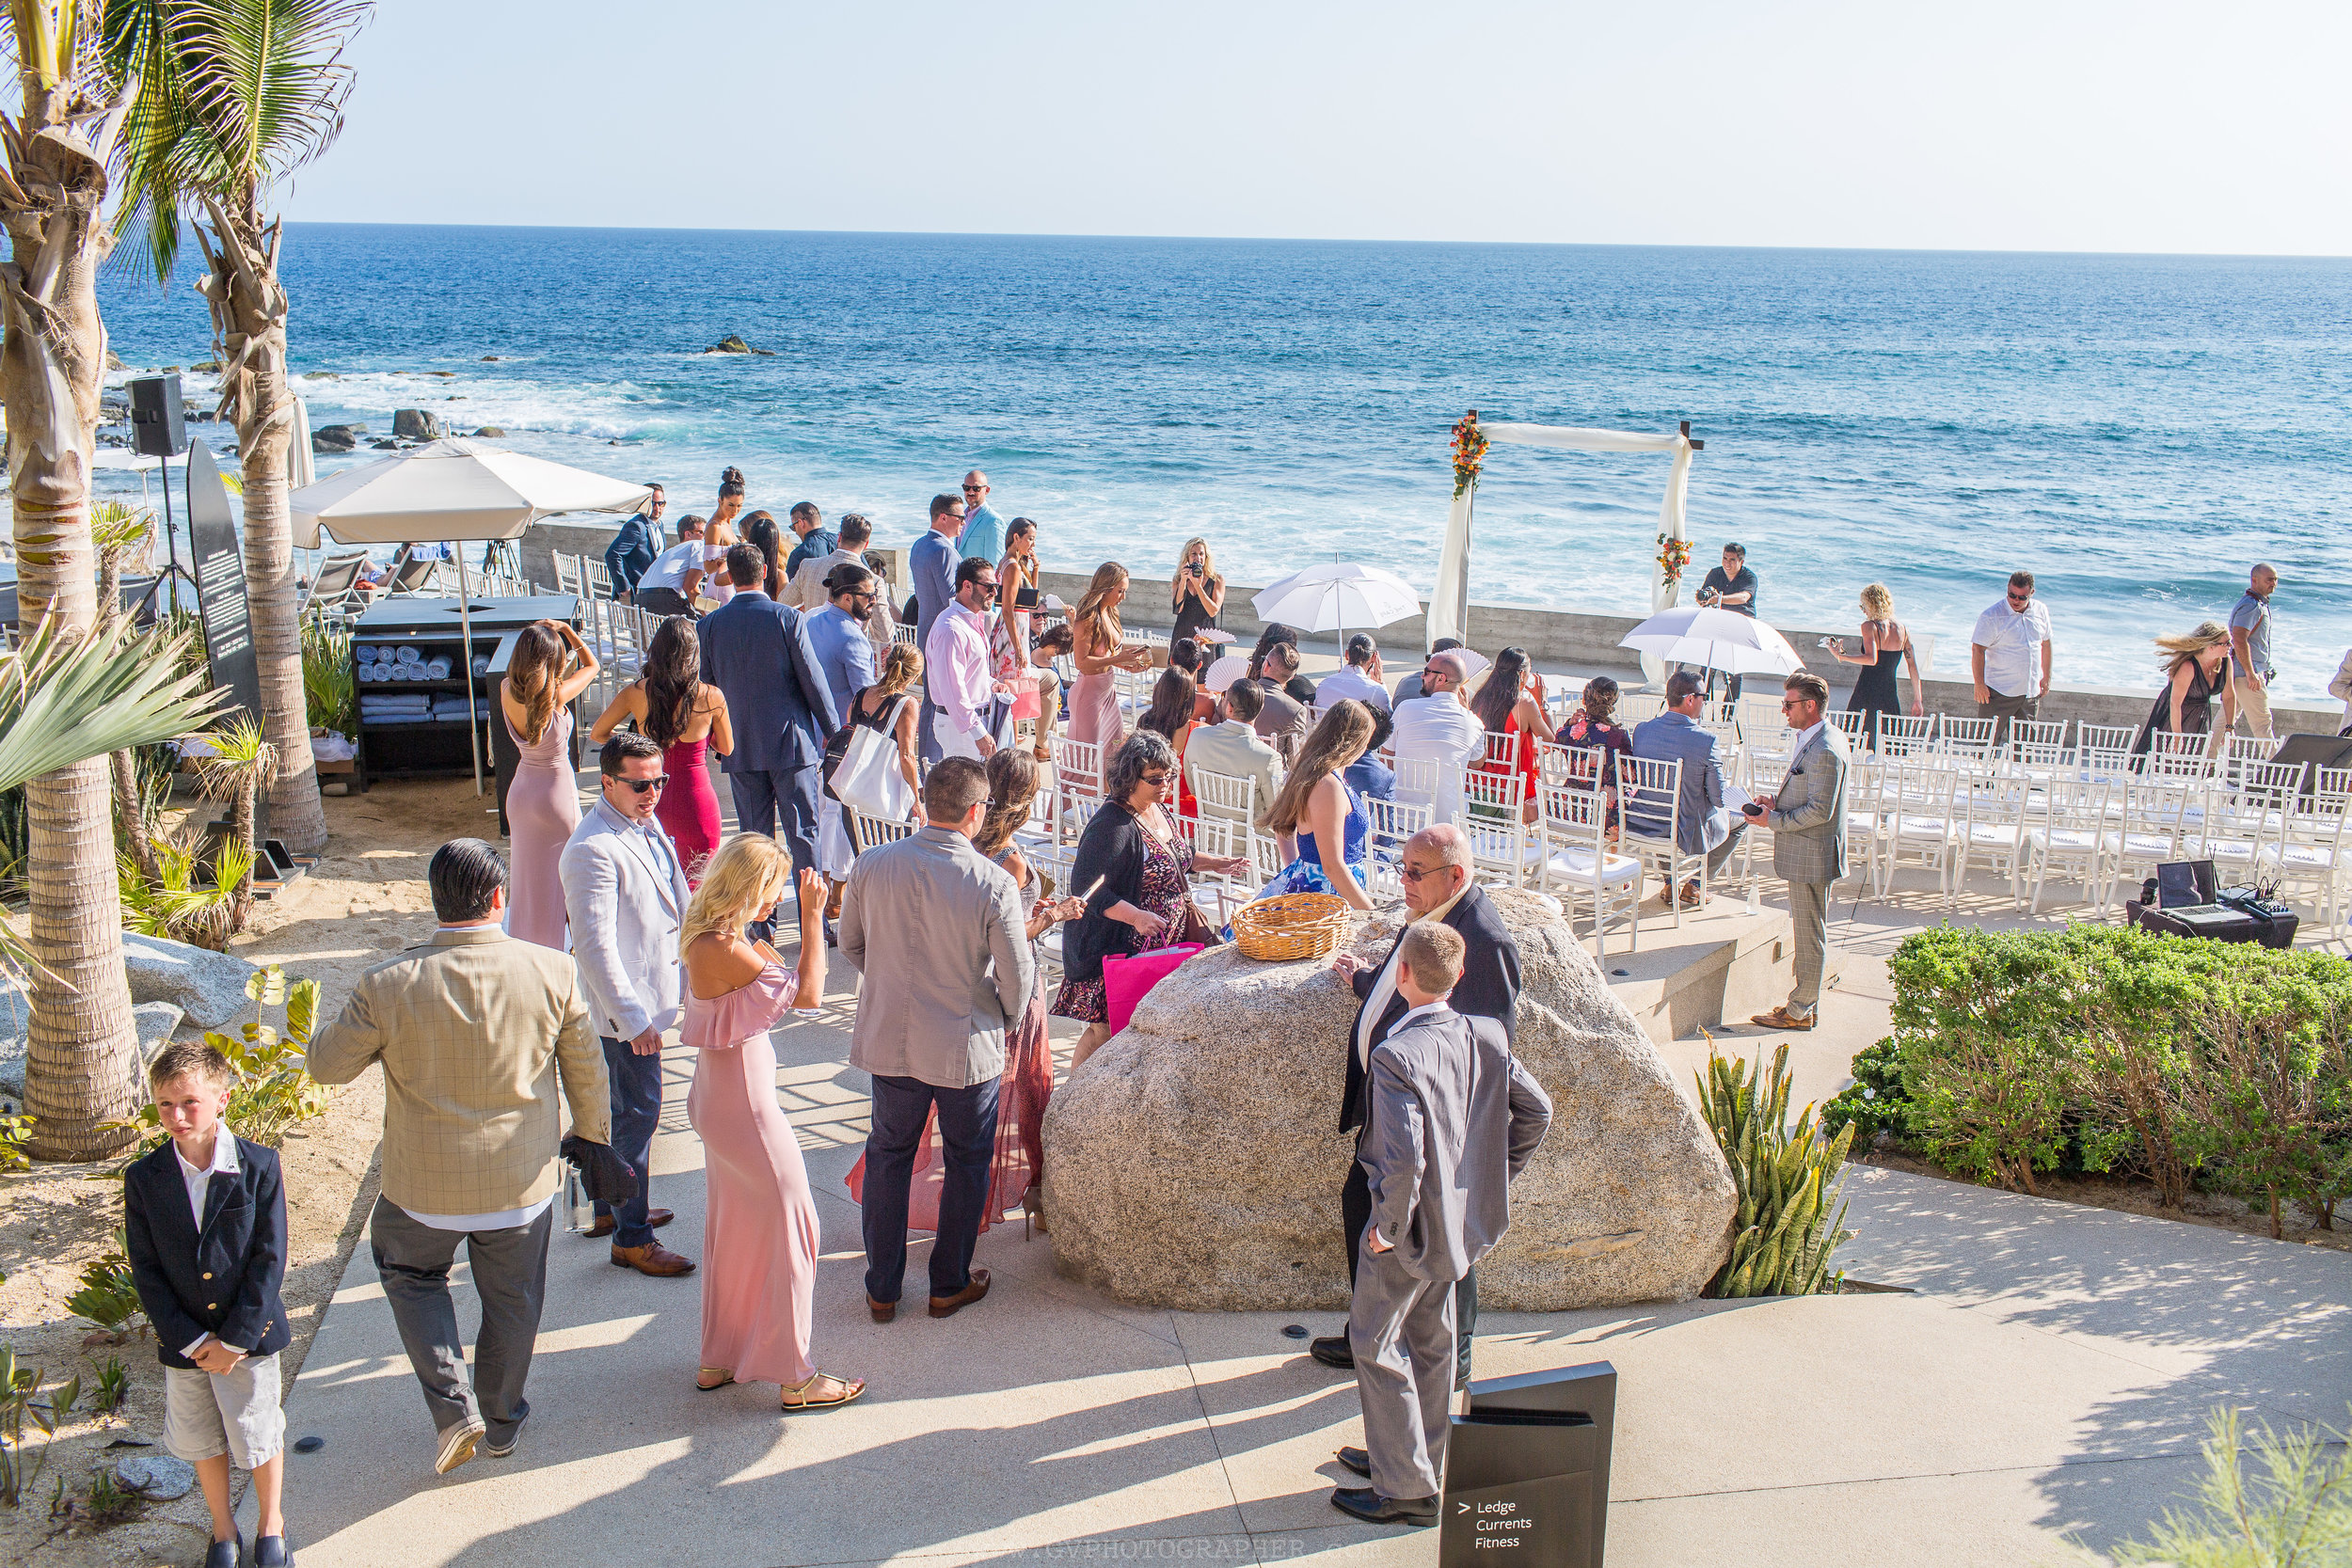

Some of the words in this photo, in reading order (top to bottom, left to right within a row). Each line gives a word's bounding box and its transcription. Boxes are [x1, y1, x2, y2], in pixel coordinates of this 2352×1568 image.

[1477, 1500, 1516, 1515] Ledge
[1476, 1518, 1533, 1531] Currents
[1475, 1537, 1519, 1548] Fitness
